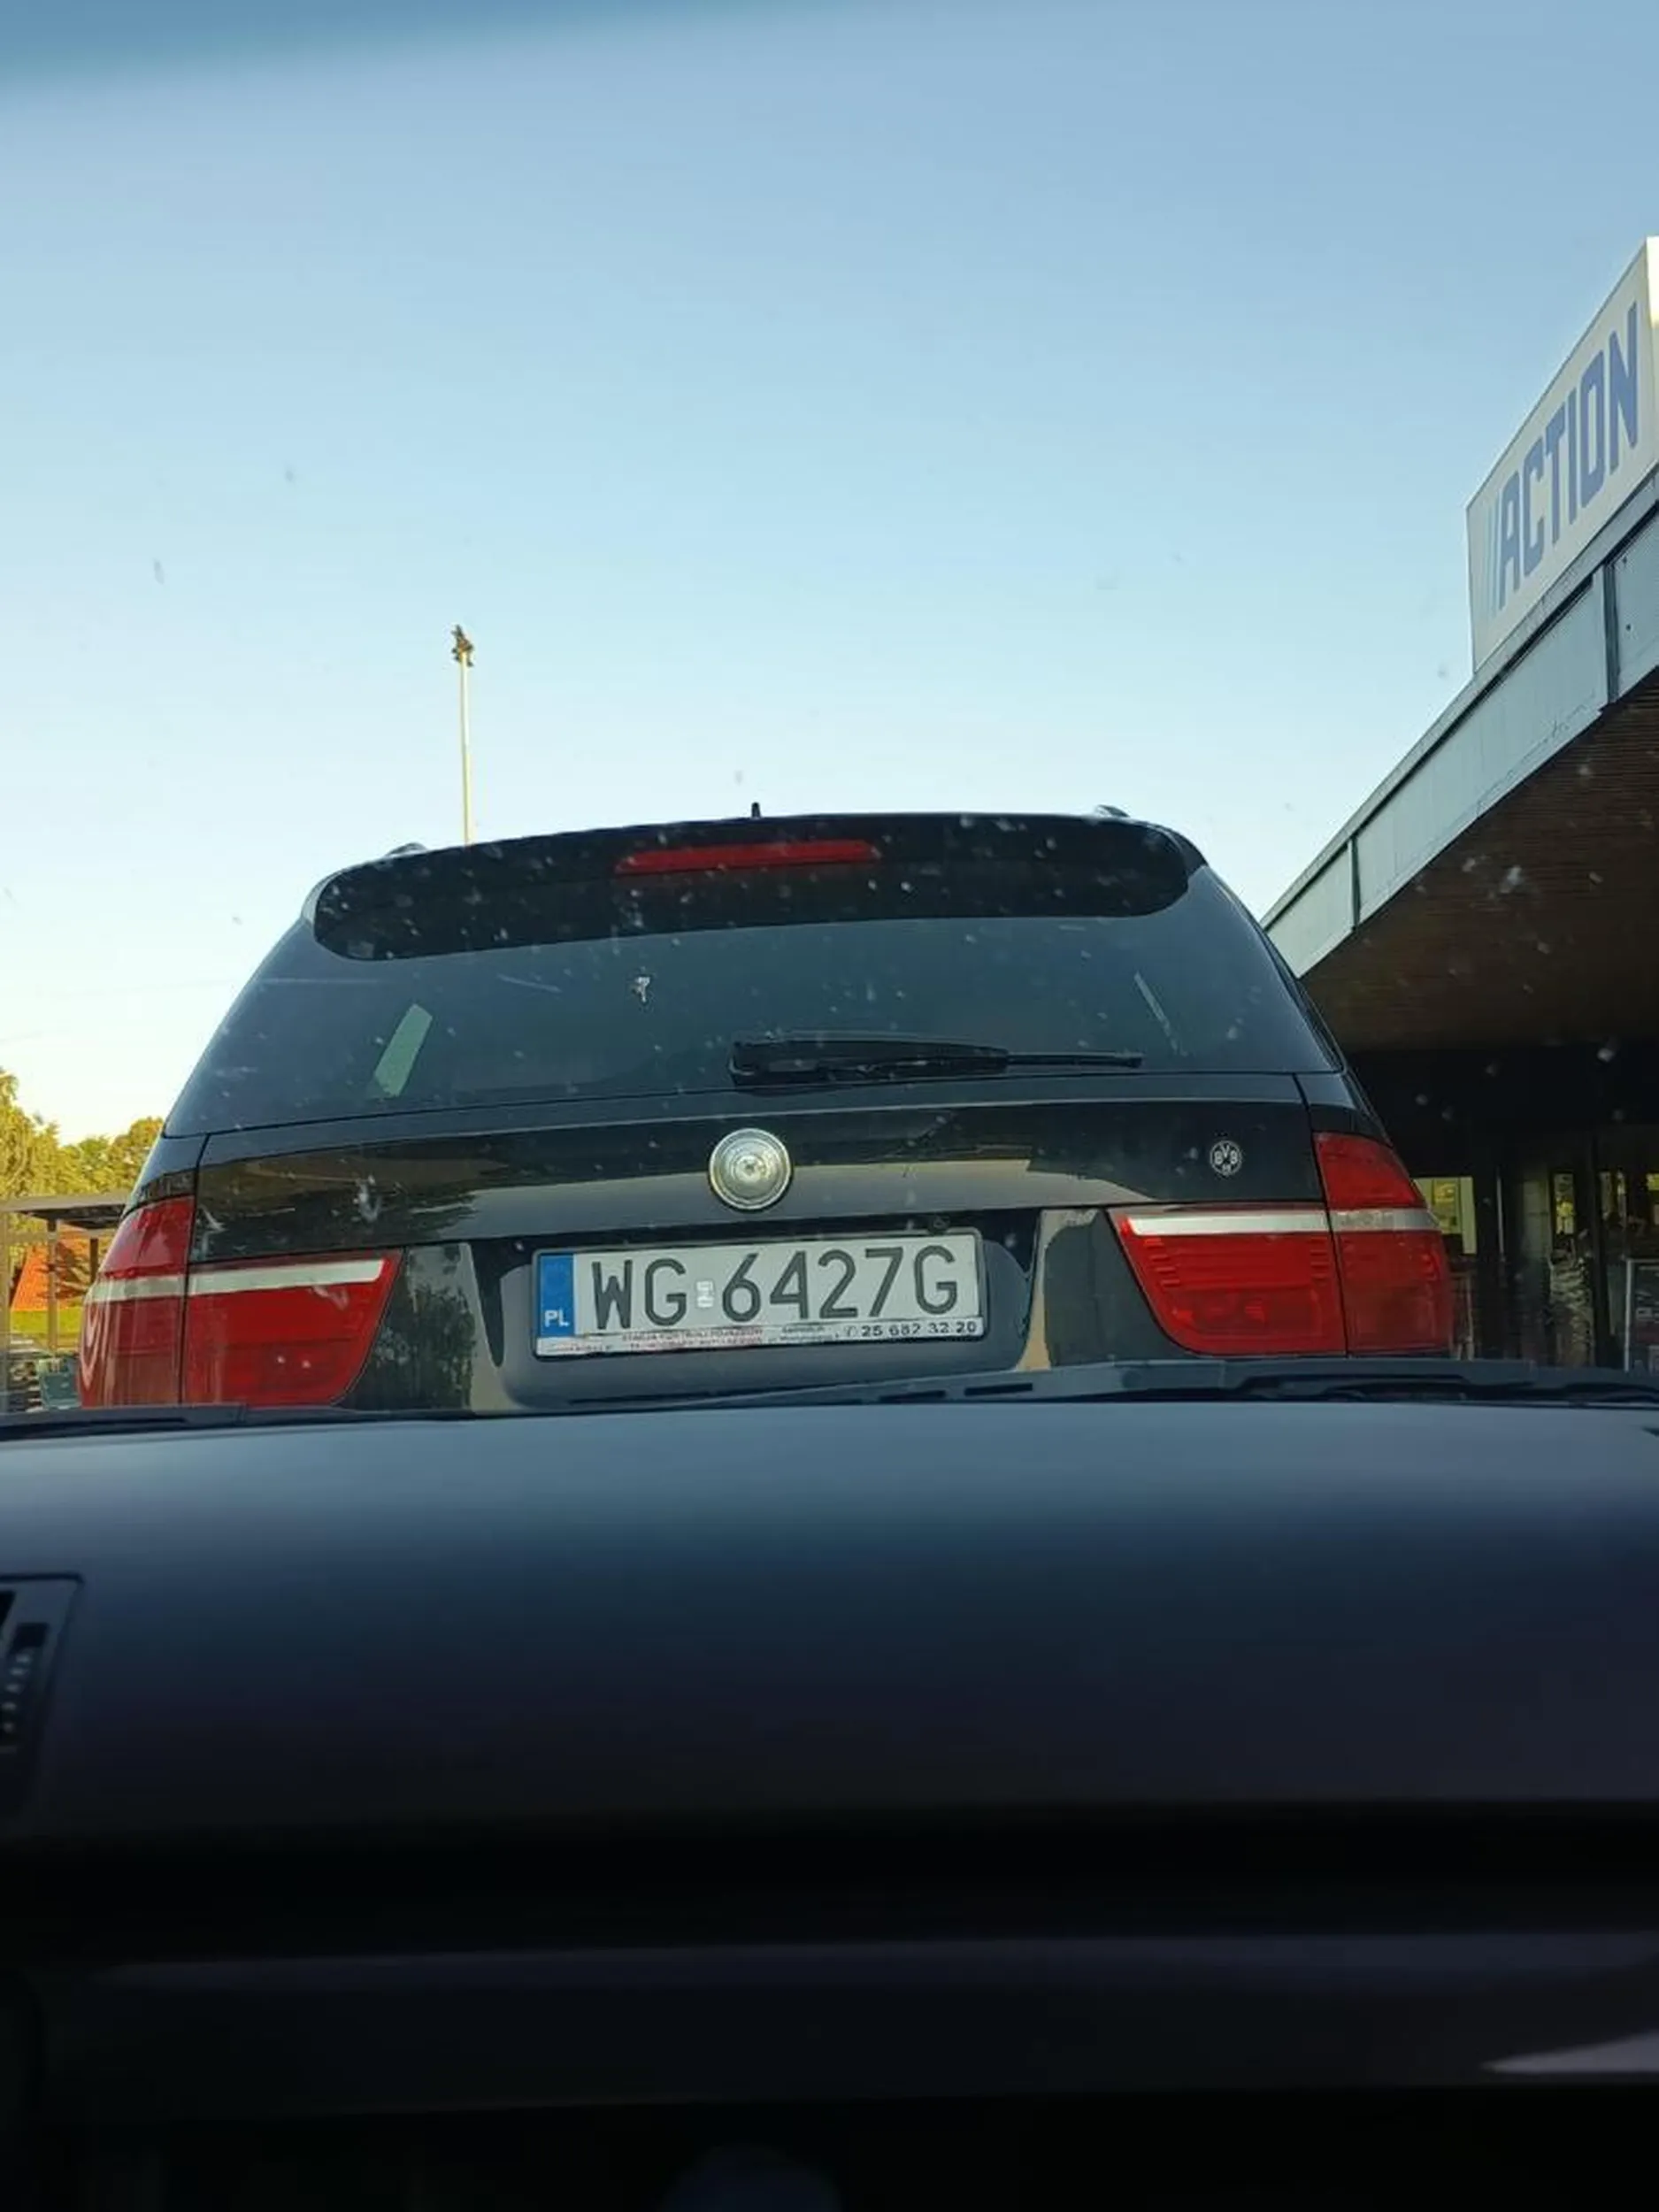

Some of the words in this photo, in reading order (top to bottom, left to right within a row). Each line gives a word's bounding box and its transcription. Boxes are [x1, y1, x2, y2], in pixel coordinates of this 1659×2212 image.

[1498, 301, 1639, 612] ACTION
[544, 1310, 569, 1327] PL
[591, 1258, 687, 1330] WG
[721, 1245, 958, 1323] 6427G
